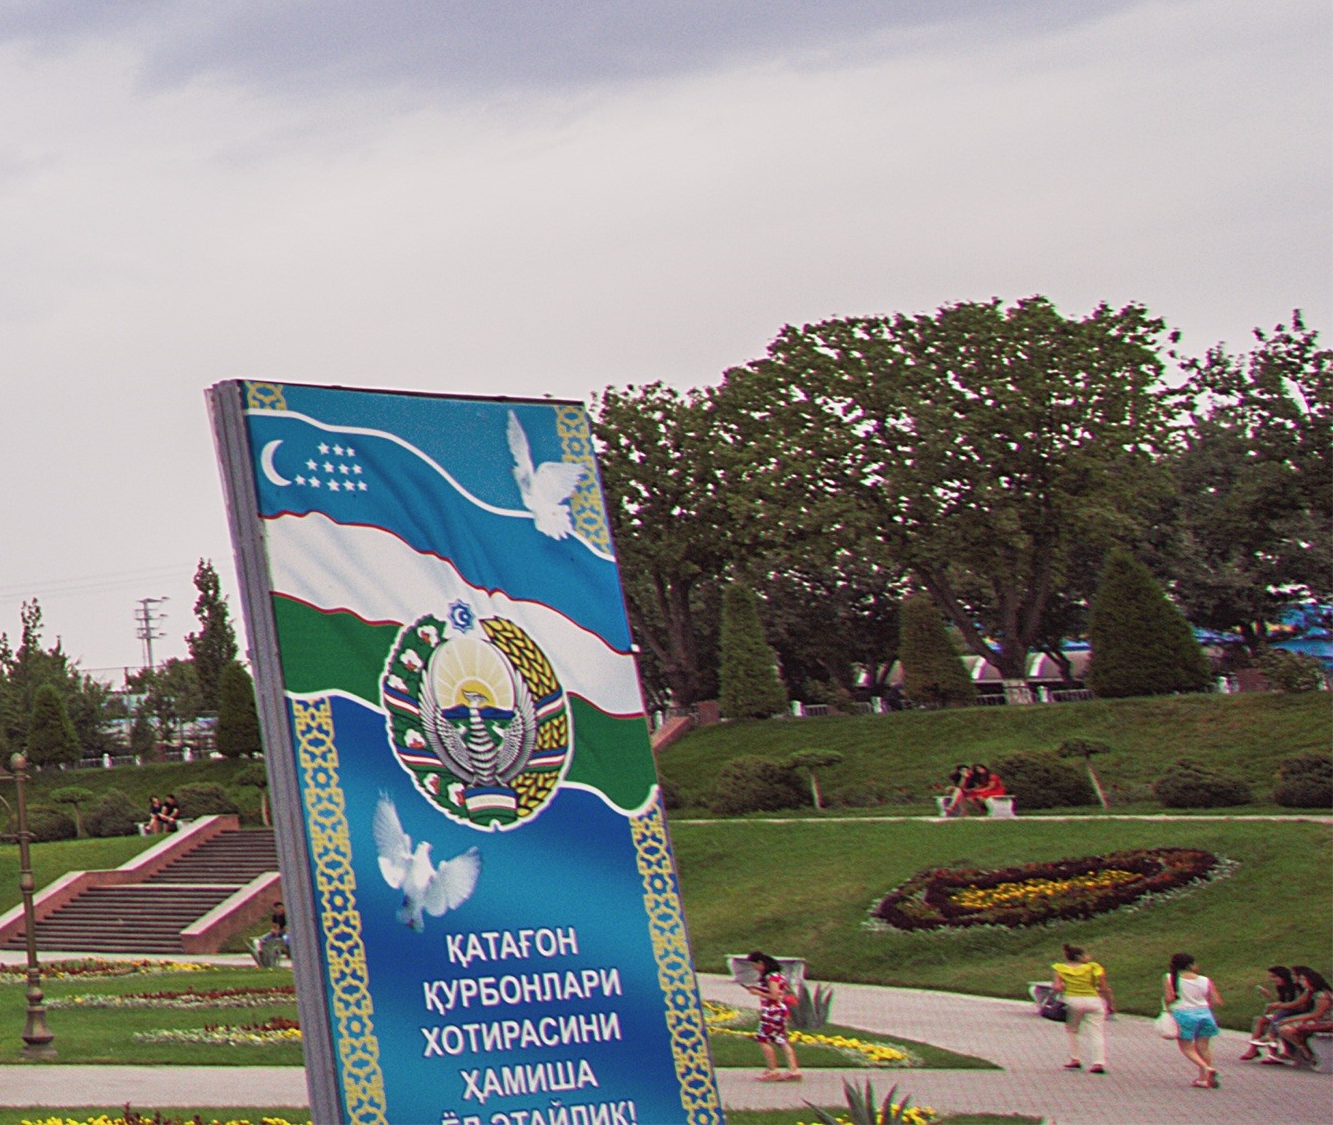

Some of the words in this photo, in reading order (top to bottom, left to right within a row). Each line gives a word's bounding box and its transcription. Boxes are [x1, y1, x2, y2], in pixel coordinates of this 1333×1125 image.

[446, 927, 579, 968] ҚАТАҒОН
[422, 967, 623, 1016] ҚУРБОНЛАРИ
[421, 1012, 622, 1057] ХОТИРАСИНИ
[460, 1059, 600, 1104] ҲАМИША
